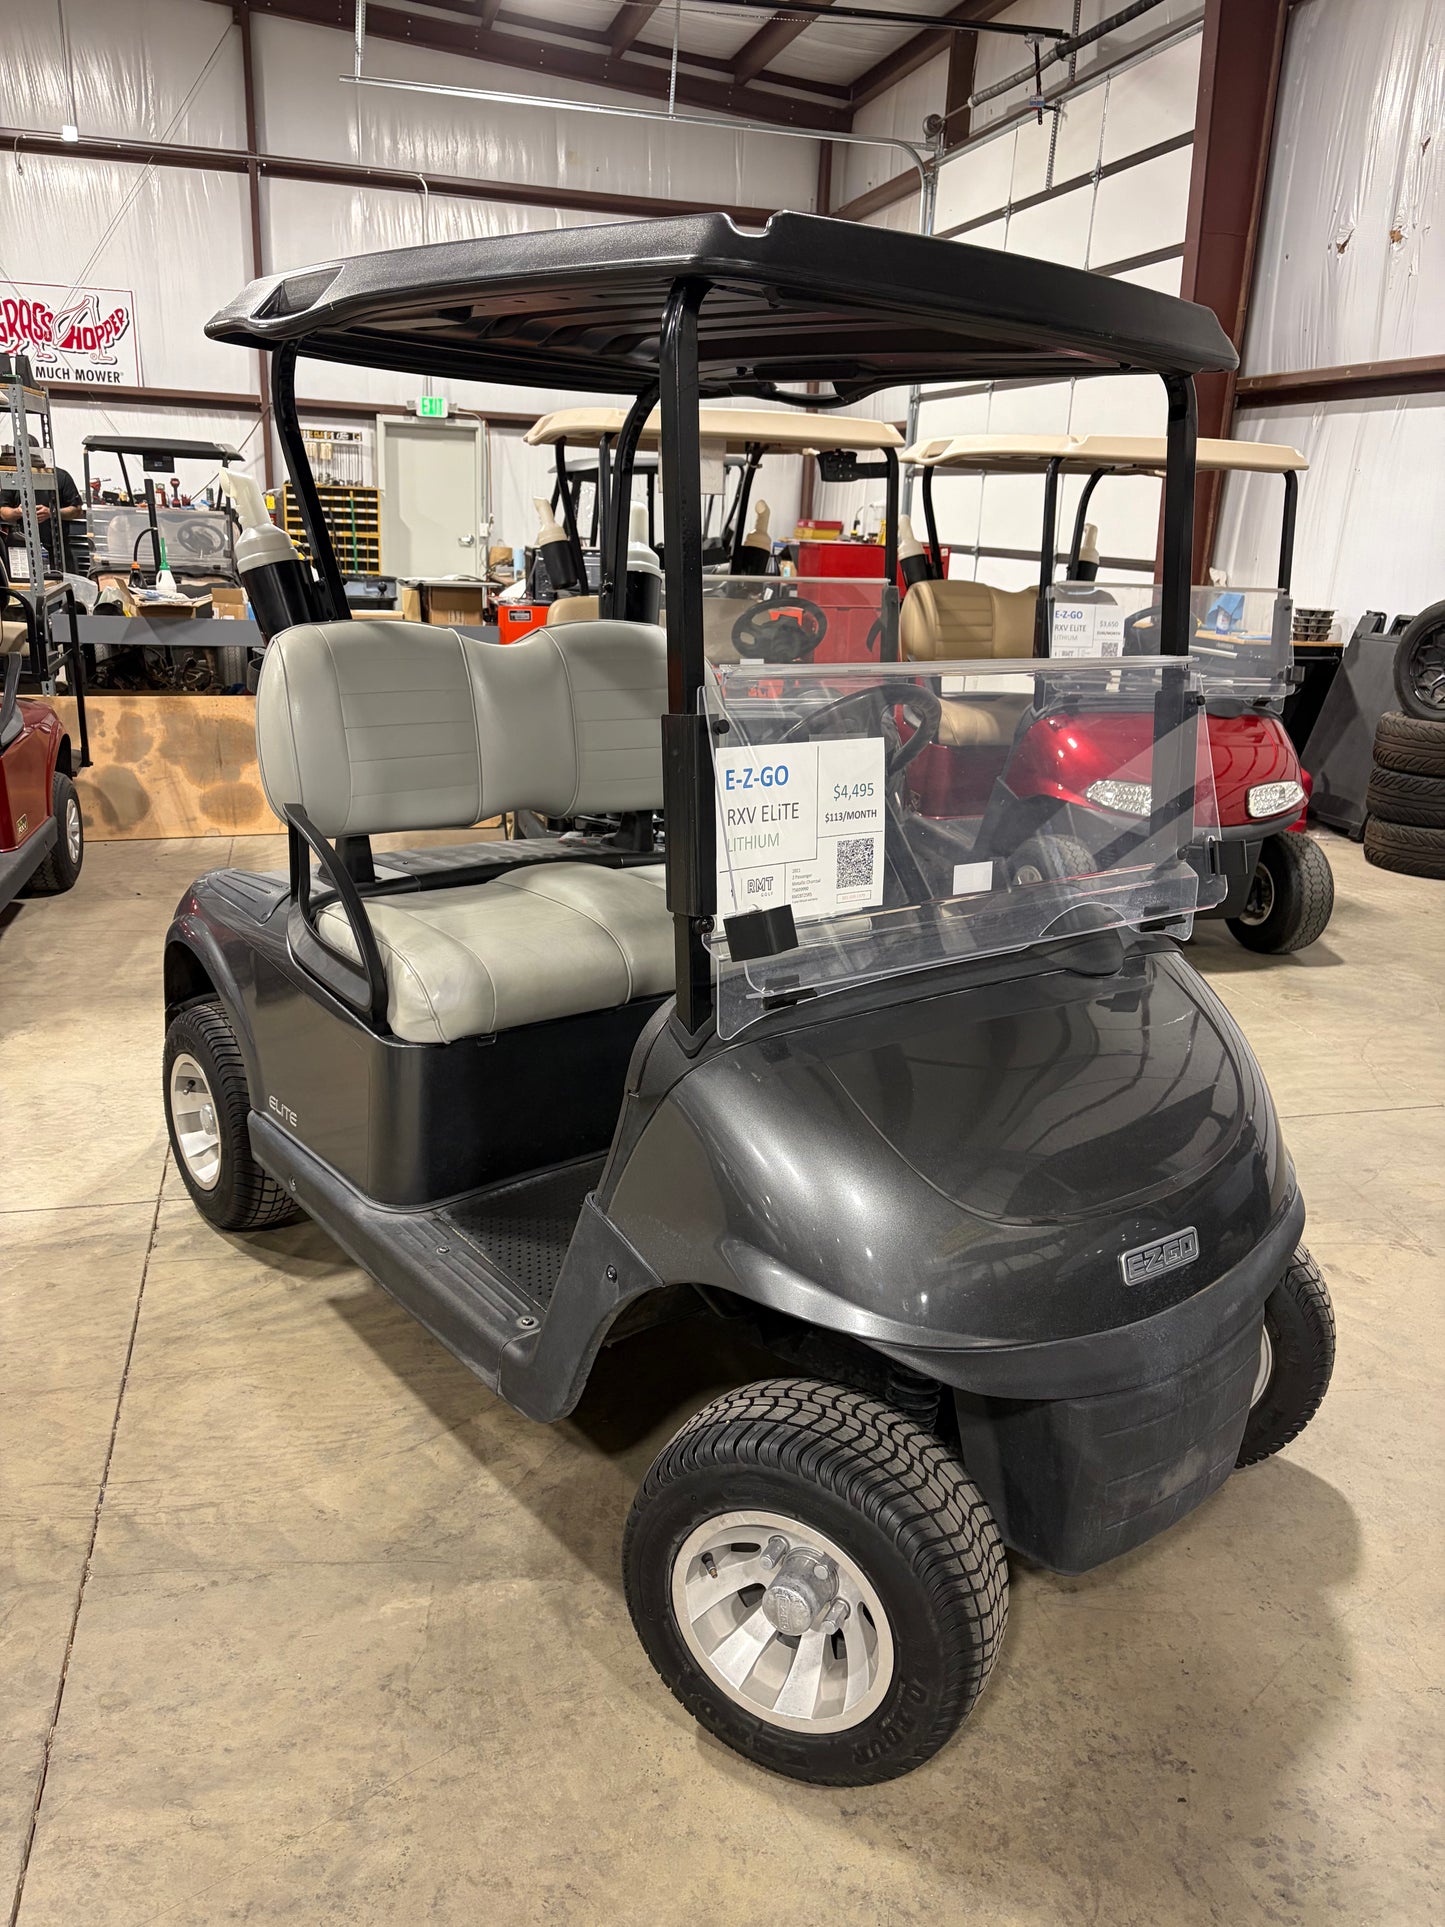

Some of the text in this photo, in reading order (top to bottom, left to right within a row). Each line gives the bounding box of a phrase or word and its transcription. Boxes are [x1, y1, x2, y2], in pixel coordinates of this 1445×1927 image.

[36, 366, 121, 383] MUCH MOWER
[421, 397, 444, 416] EXIT
[1055, 610, 1083, 619] E-Z-GO
[725, 765, 789, 791] E-Z-GO
[833, 782, 874, 801] $4,495
[727, 802, 800, 827] RXV ELiTE
[824, 809, 877, 823] $113/MONTH
[727, 832, 780, 853] LITHIUM
[747, 876, 774, 893] RMT
